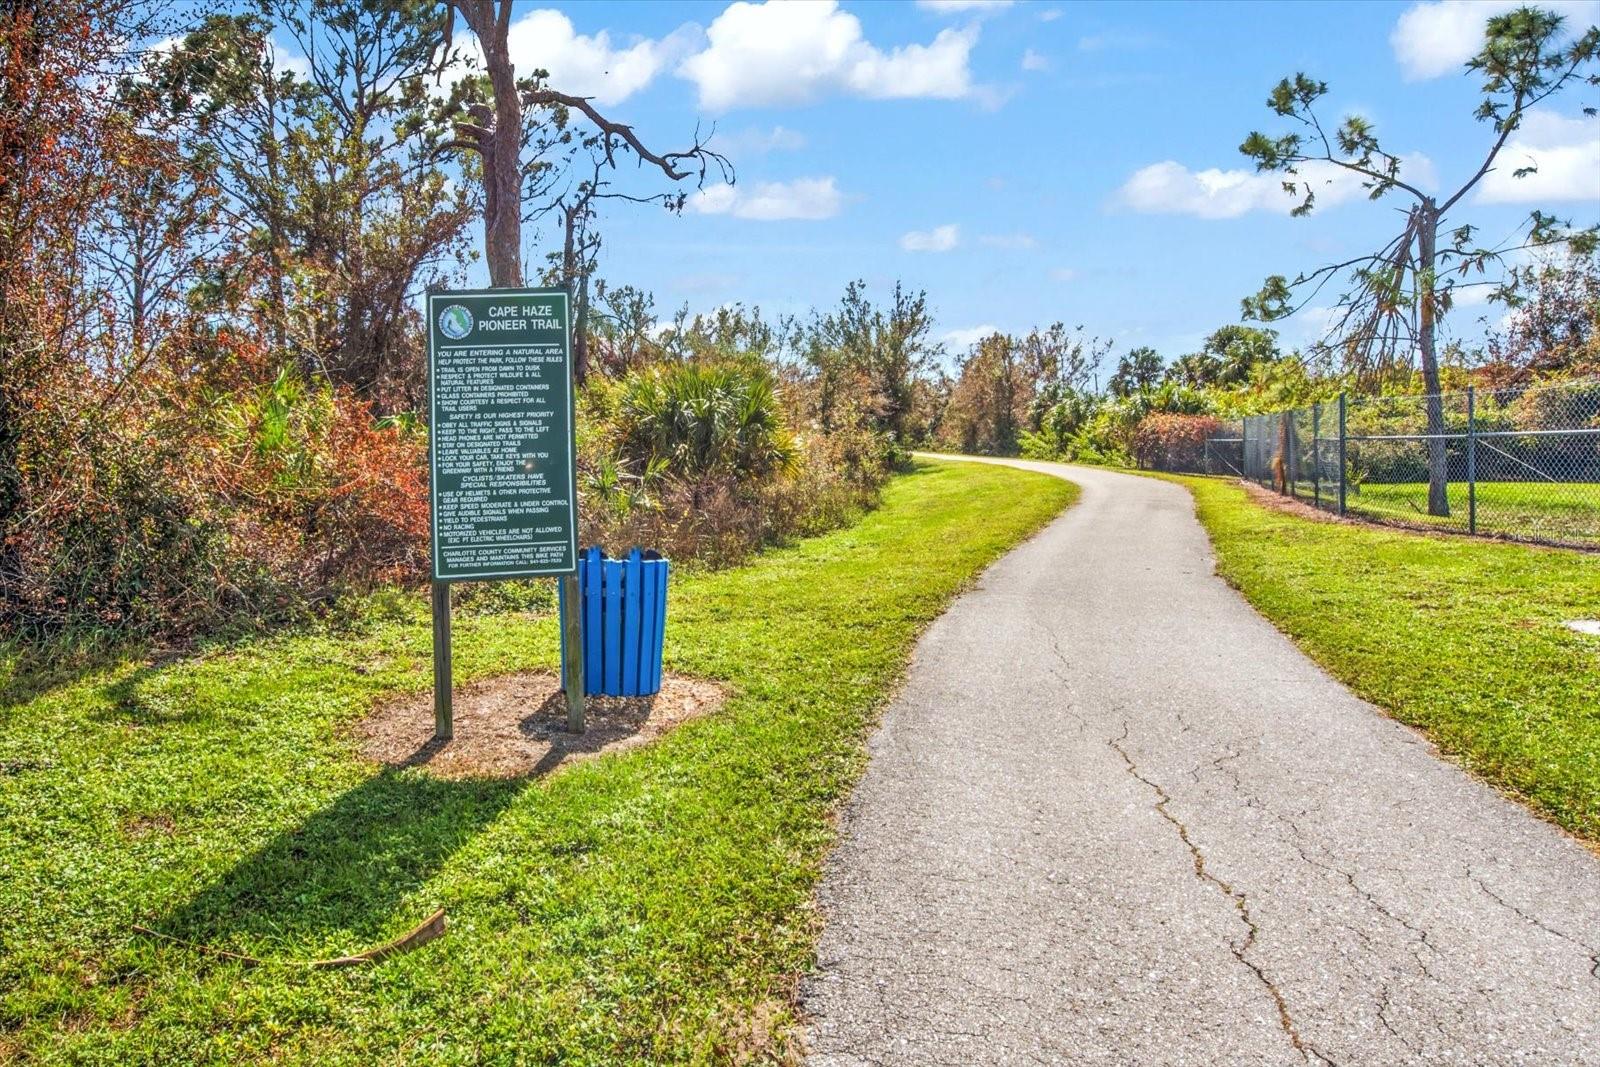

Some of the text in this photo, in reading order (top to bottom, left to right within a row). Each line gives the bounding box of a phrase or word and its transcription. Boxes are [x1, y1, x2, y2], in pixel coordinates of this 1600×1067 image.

[489, 306, 552, 317] CAPE HAZE
[479, 319, 562, 330] PIONEER TRAIL
